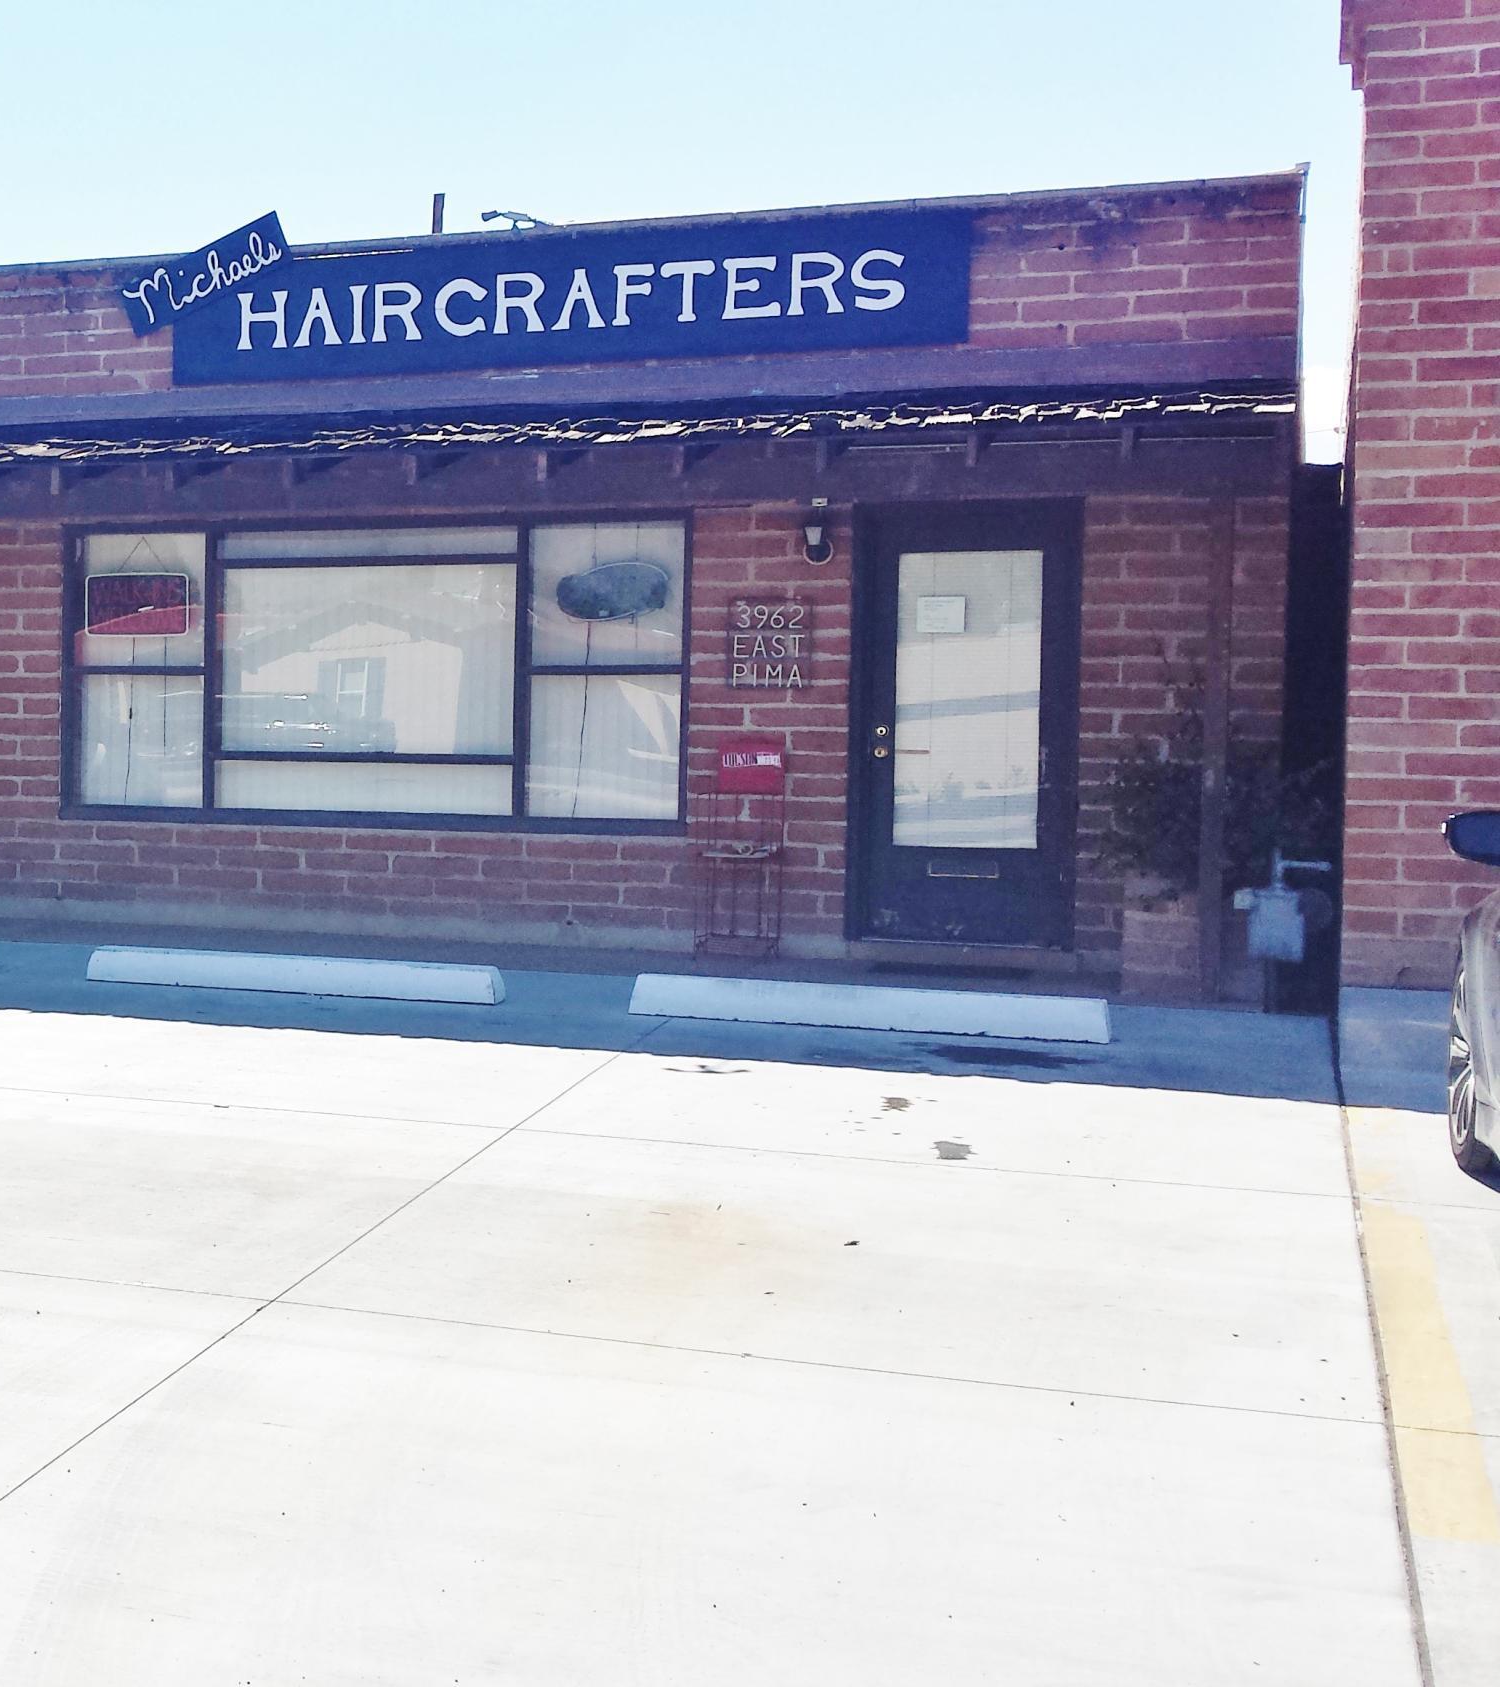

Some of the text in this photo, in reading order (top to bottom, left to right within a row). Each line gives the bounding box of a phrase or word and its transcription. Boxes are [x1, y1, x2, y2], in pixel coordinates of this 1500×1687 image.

[122, 231, 282, 324] Michaels
[735, 605, 804, 628] 3962
[733, 634, 805, 658] EAST
[732, 664, 803, 688] PIMA
